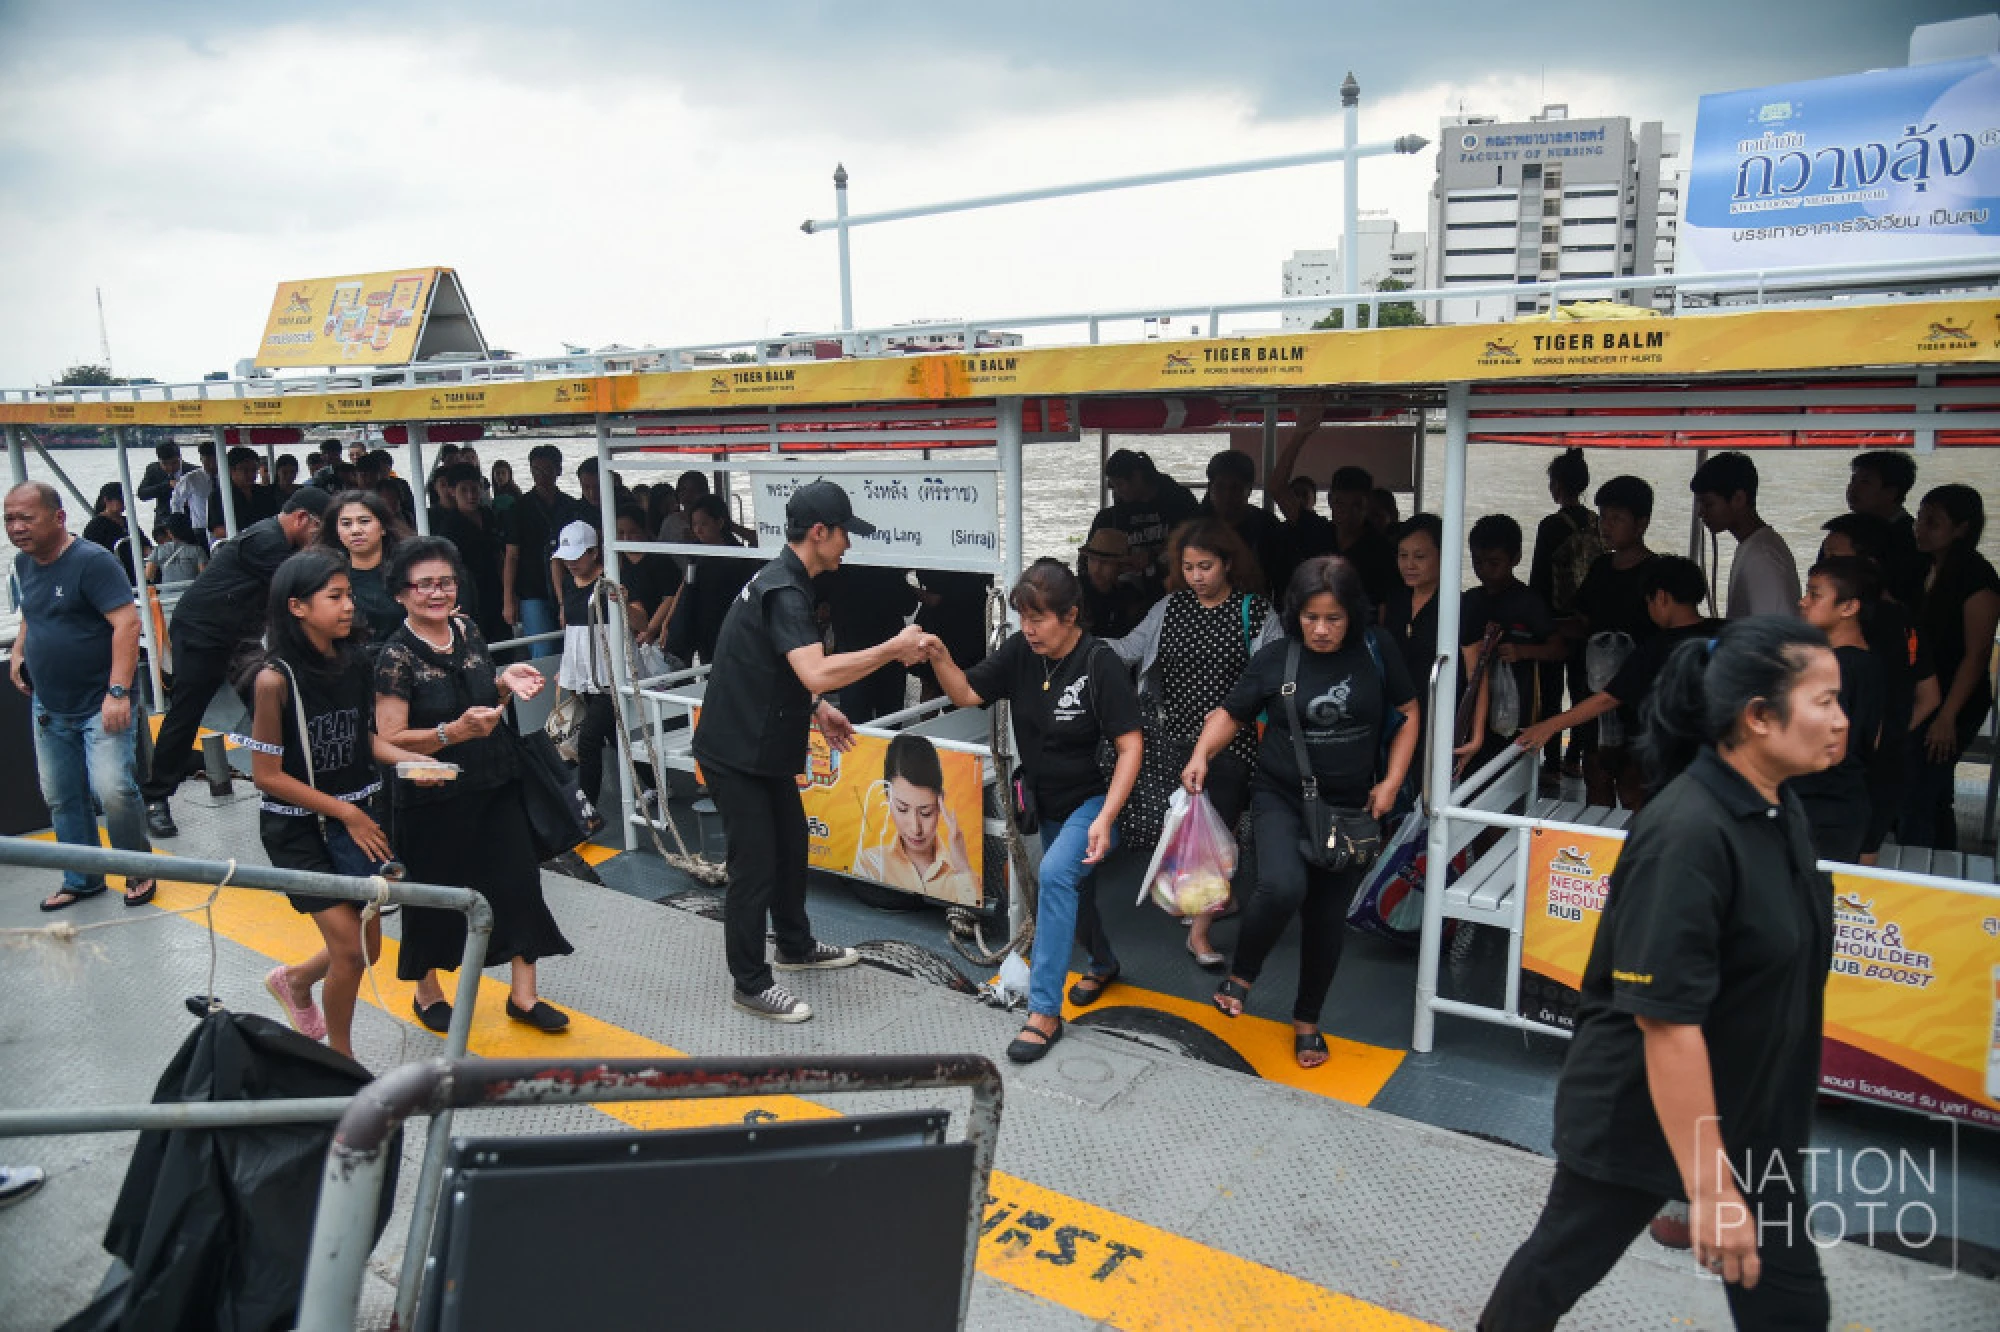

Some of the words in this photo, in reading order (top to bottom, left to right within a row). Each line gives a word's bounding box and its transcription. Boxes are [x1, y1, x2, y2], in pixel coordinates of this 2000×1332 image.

[1459, 151, 1518, 163] FACULTY
[1523, 149, 1541, 159] OF
[1548, 145, 1604, 158] NURSING
[1732, 123, 1977, 199] กวางลุ้ง
[1533, 333, 1594, 350] TIGER
[1603, 331, 1663, 349] BALM
[1203, 347, 1251, 362] TIGER
[1257, 346, 1304, 361] BALM
[980, 358, 1017, 371] BALM
[733, 371, 762, 384] TIGER
[766, 370, 796, 383] BALM
[863, 479, 909, 500] วังหลัง
[758, 522, 781, 535] Phra
[893, 528, 922, 546] Lang
[951, 529, 996, 549] (Siriraj)
[1551, 875, 1594, 895] NECK
[1549, 889, 1604, 911] SHOUL
[1548, 903, 1581, 921] RUB
[1882, 923, 1902, 949] &
[1835, 940, 1930, 969] HOULDER
[1833, 959, 1860, 975] UB
[1865, 964, 1935, 987] BOOST
